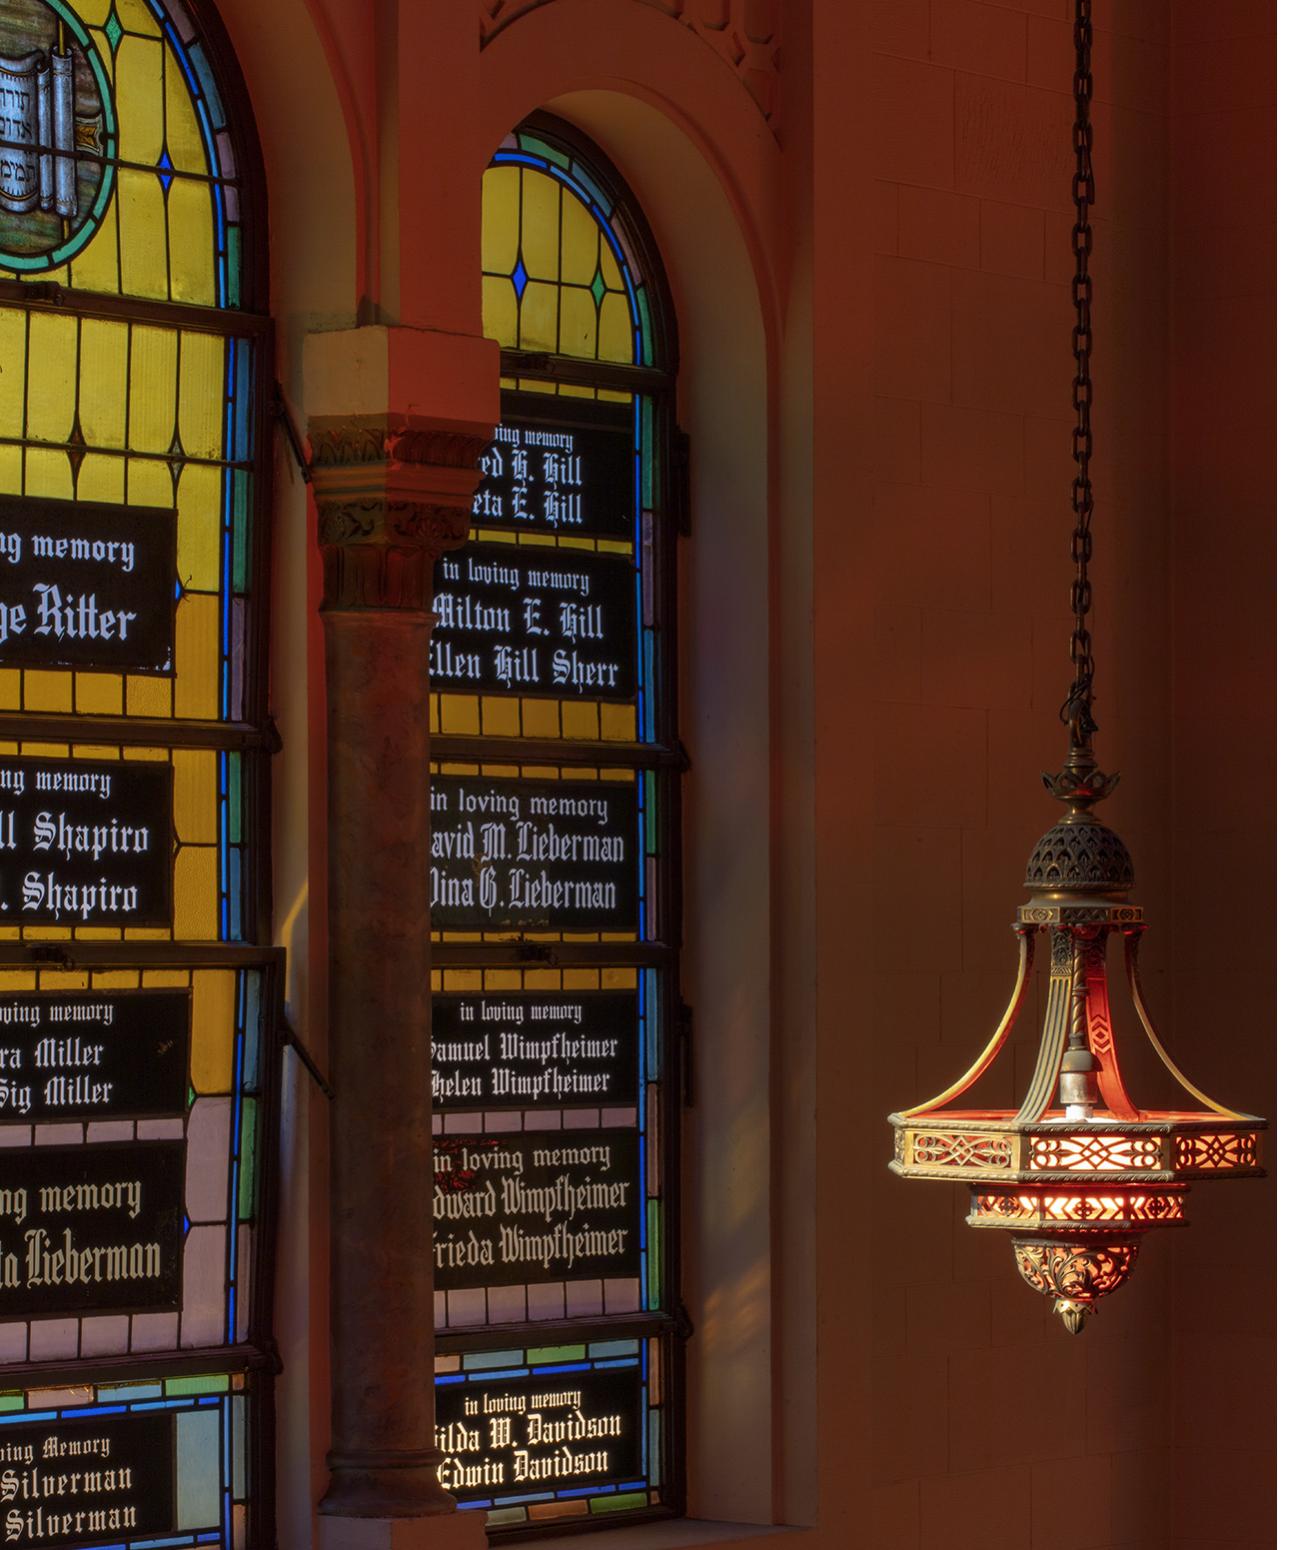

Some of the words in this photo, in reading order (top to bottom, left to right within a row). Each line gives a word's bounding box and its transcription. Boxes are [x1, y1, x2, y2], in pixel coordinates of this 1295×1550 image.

[0, 160, 36, 182] תמימ
[524, 430, 573, 454] memory
[480, 447, 503, 477] ed
[512, 449, 534, 487] H.
[543, 452, 582, 490] Hill
[472, 489, 502, 517] eta
[512, 487, 535, 520] E.
[544, 491, 582, 528] Hill
[32, 535, 135, 572] memory
[443, 558, 459, 580] in
[468, 557, 519, 591] loving
[528, 569, 589, 596] memory
[32, 582, 137, 641] Ritter
[432, 592, 511, 632] Milton
[523, 598, 550, 636] E.
[560, 602, 604, 644] Hill
[494, 645, 540, 688] Hill
[552, 649, 619, 694] Sherr
[36, 770, 111, 799] memory
[430, 786, 448, 811] in
[459, 788, 519, 821] loving
[530, 796, 608, 825] memory
[33, 811, 149, 861] Shapiro
[431, 821, 475, 859] avid
[480, 822, 512, 862] M.
[516, 821, 625, 862] Lieberman
[22, 872, 138, 920] Shapiro
[509, 868, 616, 909] Lieberman
[0, 1002, 40, 1028] ving
[50, 1004, 114, 1026] memory
[460, 1002, 474, 1021] in
[481, 1000, 524, 1025] loving
[531, 1004, 582, 1025] memory
[34, 1037, 104, 1068] Miller
[500, 1032, 618, 1065] Wimpfheimer
[44, 1075, 113, 1106] Miller
[492, 1067, 610, 1100] Wimpfheimer
[433, 1149, 452, 1172] in
[462, 1147, 524, 1175] loving
[533, 1146, 611, 1171] memory
[39, 1181, 141, 1219] memory
[432, 1180, 496, 1219] dward
[501, 1173, 630, 1223] Wimpfheimer
[24, 1227, 161, 1289] Lieberman
[432, 1230, 495, 1268] rieda
[499, 1221, 628, 1269] Wimpfheimer
[465, 1397, 478, 1416] in
[483, 1393, 526, 1415] loving
[531, 1390, 582, 1410] memory
[42, 1436, 110, 1459] Memory
[434, 1422, 480, 1455] ilda
[490, 1417, 518, 1449] W.
[527, 1410, 622, 1445] Davidson
[0, 1467, 132, 1503] Silverman
[436, 1457, 504, 1490] Edwin
[513, 1445, 609, 1482] Davidson
[5, 1506, 137, 1542] Silverman
